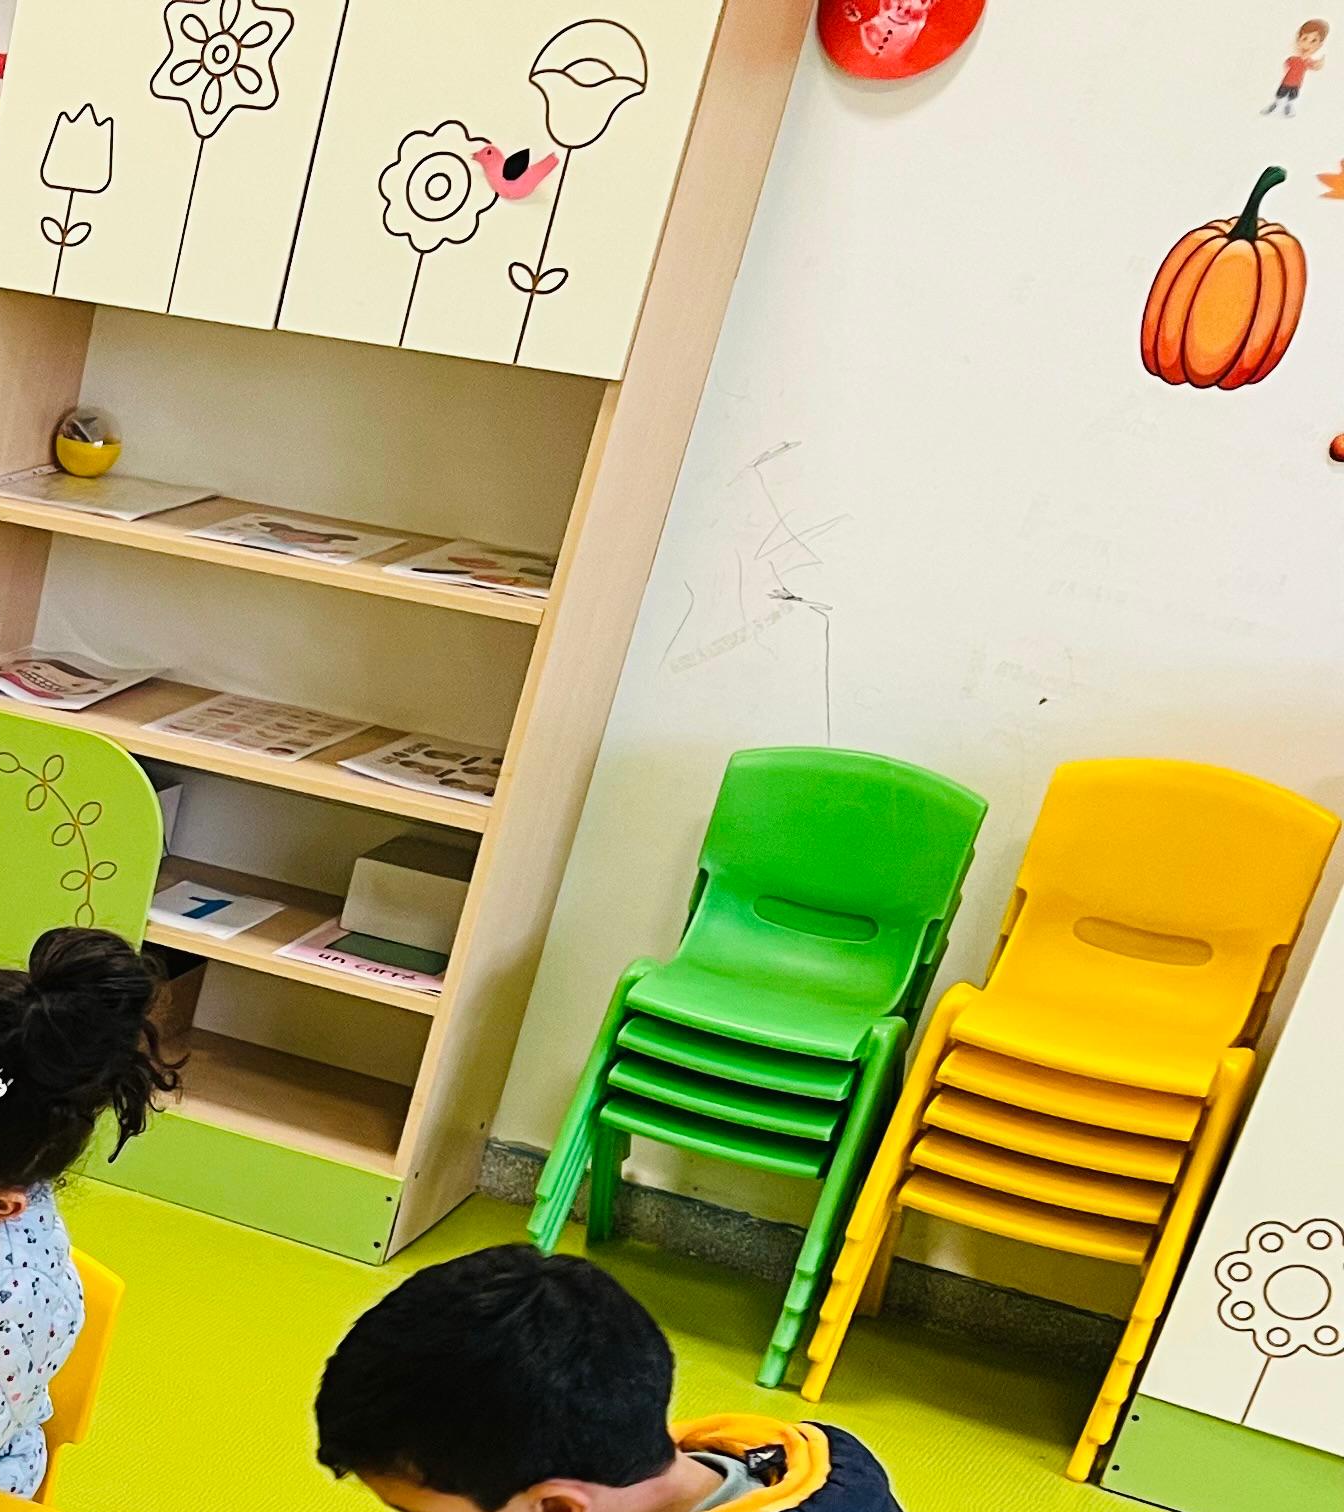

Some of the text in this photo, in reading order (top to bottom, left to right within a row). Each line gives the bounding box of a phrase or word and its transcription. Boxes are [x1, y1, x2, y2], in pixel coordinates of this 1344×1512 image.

[182, 896, 233, 919] 1
[317, 951, 418, 981] un carré
